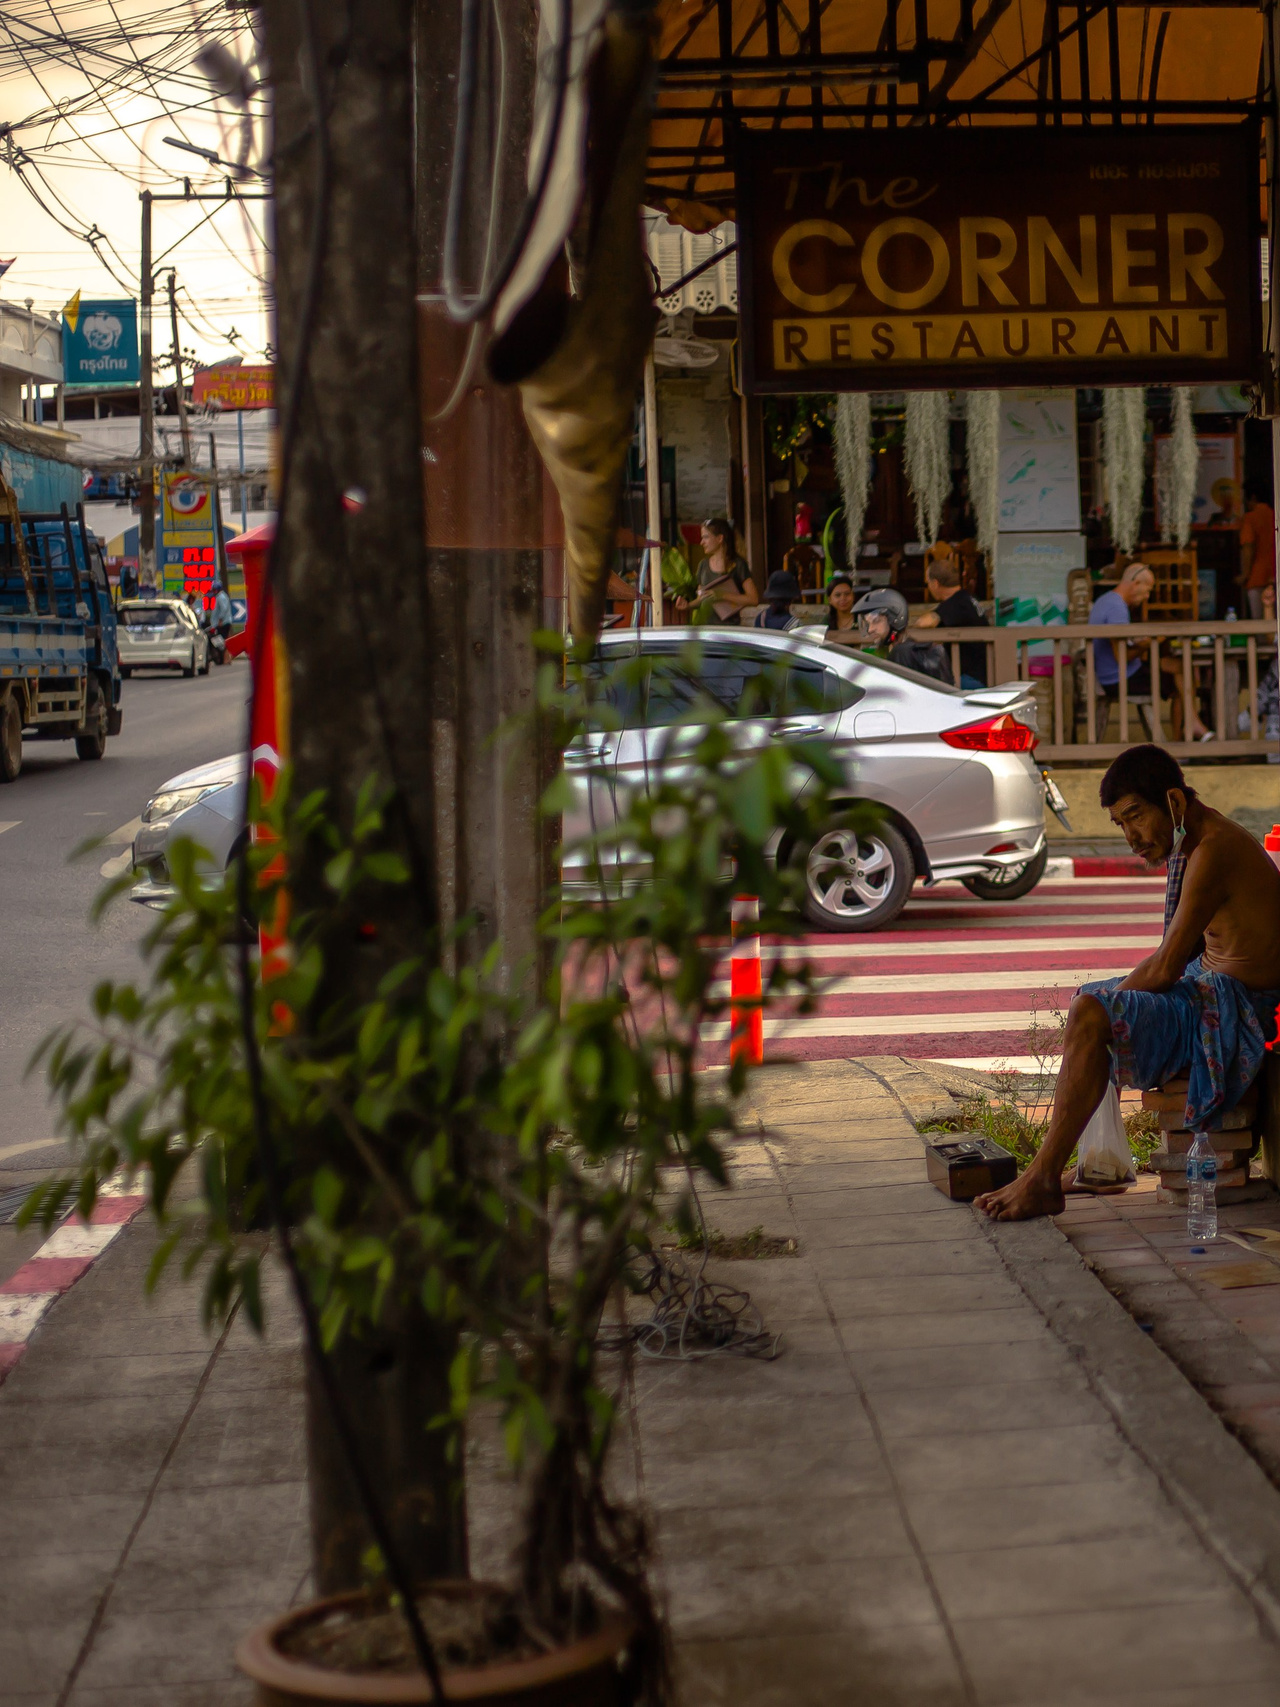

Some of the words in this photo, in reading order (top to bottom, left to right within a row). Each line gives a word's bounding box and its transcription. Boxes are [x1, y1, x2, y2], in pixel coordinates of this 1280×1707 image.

[772, 160, 940, 211] The
[771, 212, 1225, 313] CORNER
[782, 314, 1220, 363] RESTAURANT
[79, 355, 128, 375] กรุงไทย
